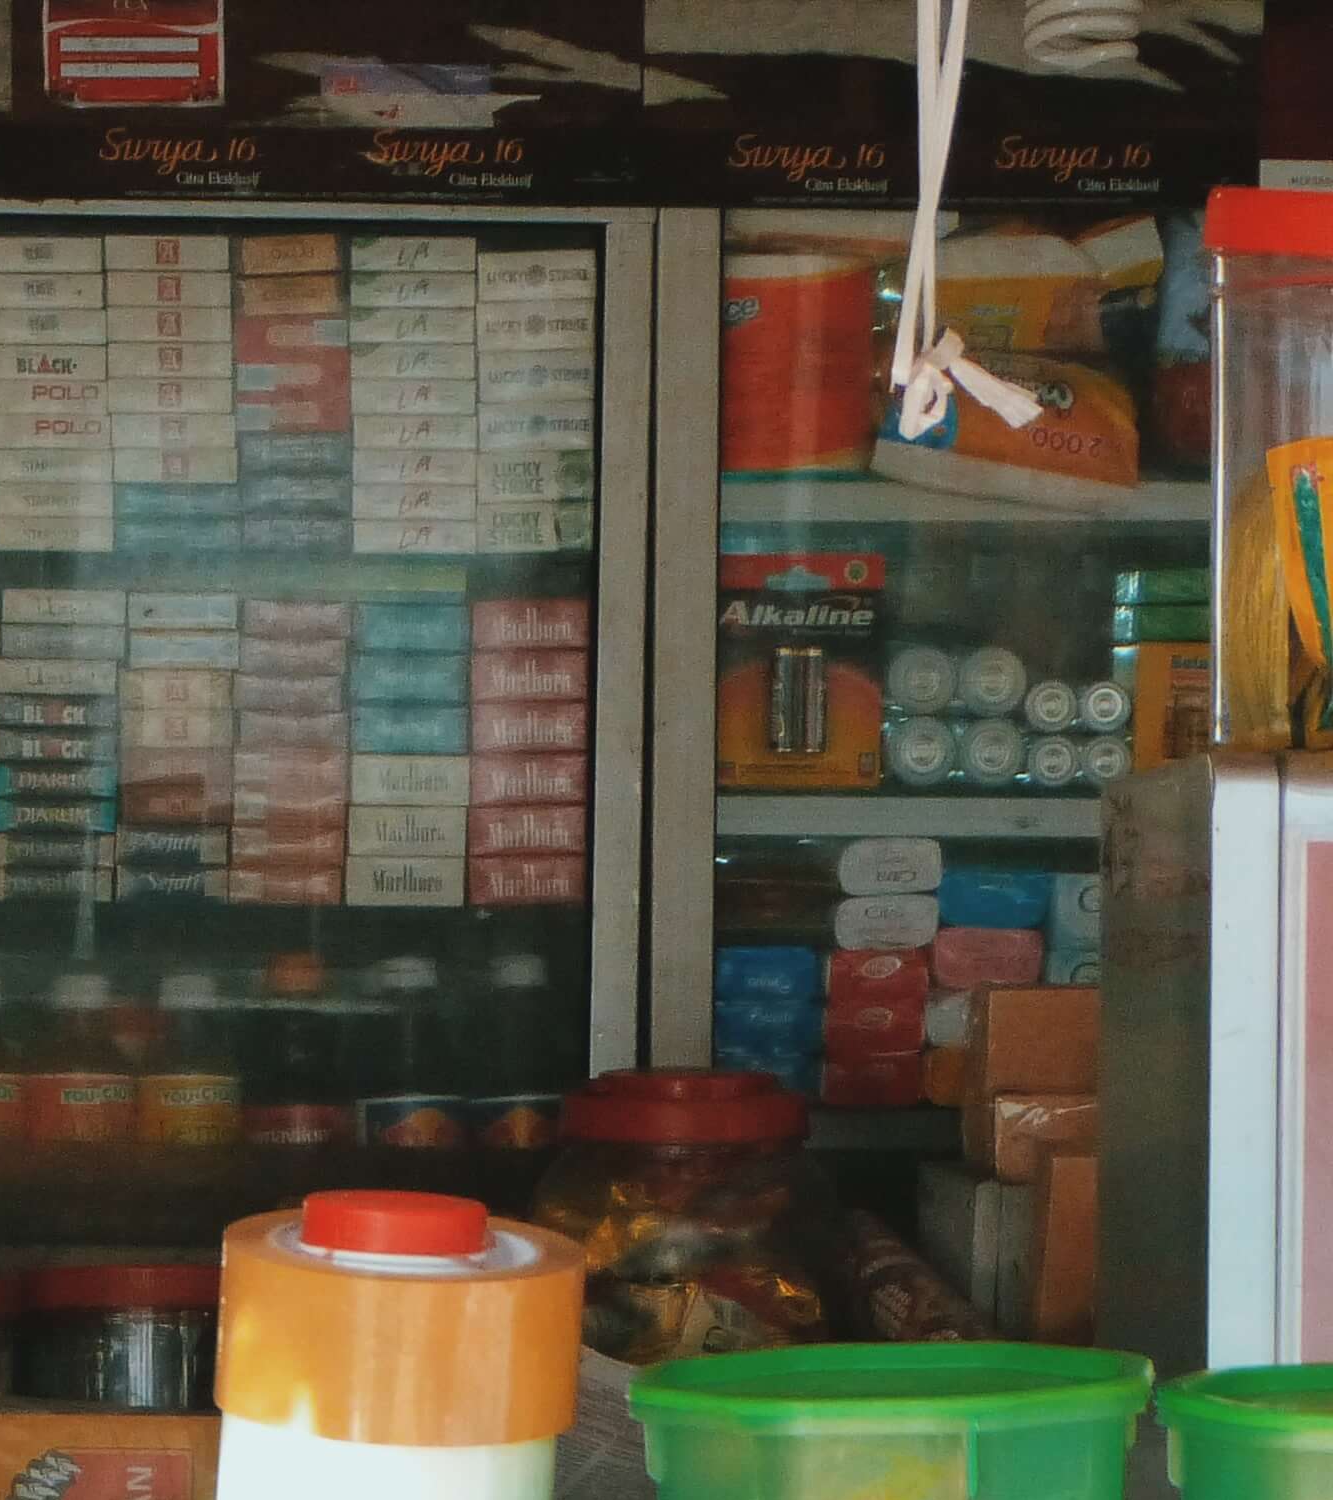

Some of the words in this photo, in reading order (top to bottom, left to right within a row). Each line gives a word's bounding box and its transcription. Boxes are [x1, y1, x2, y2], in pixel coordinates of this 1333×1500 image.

[227, 138, 255, 161] 16
[495, 138, 523, 162] 16
[856, 143, 885, 168] 16
[1123, 144, 1151, 168] 16
[32, 385, 99, 400] POLO
[34, 420, 101, 435] POLO
[719, 599, 874, 626] Alkaline
